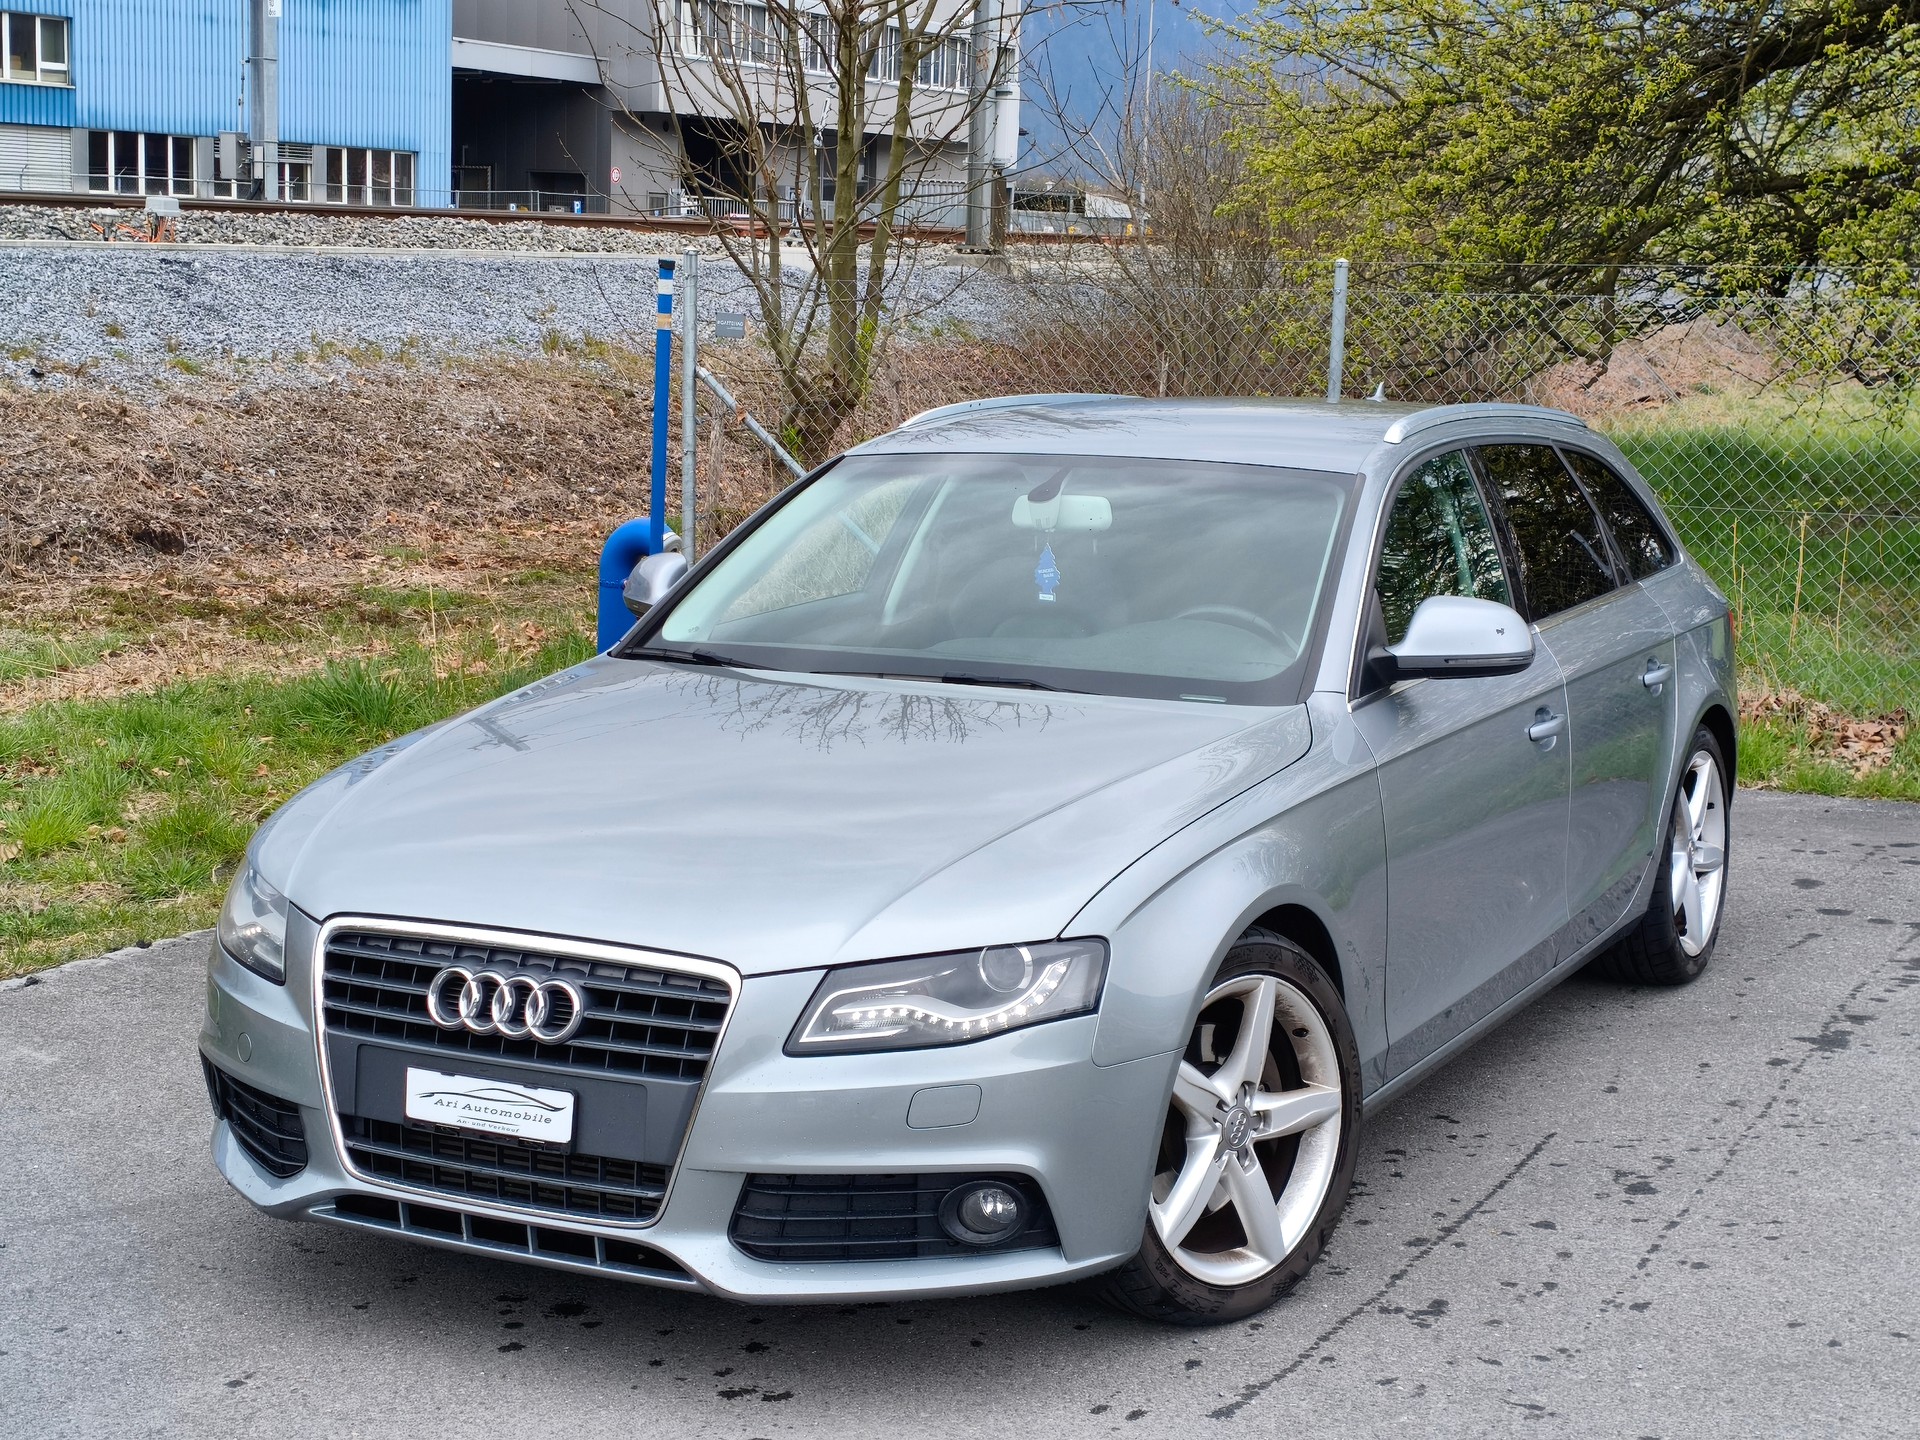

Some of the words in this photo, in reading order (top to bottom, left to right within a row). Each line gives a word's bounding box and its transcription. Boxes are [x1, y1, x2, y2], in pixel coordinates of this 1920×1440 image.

[434, 1098, 459, 1109] Ari
[461, 1103, 552, 1124] Automobile
[488, 1124, 520, 1133] Verkauf
